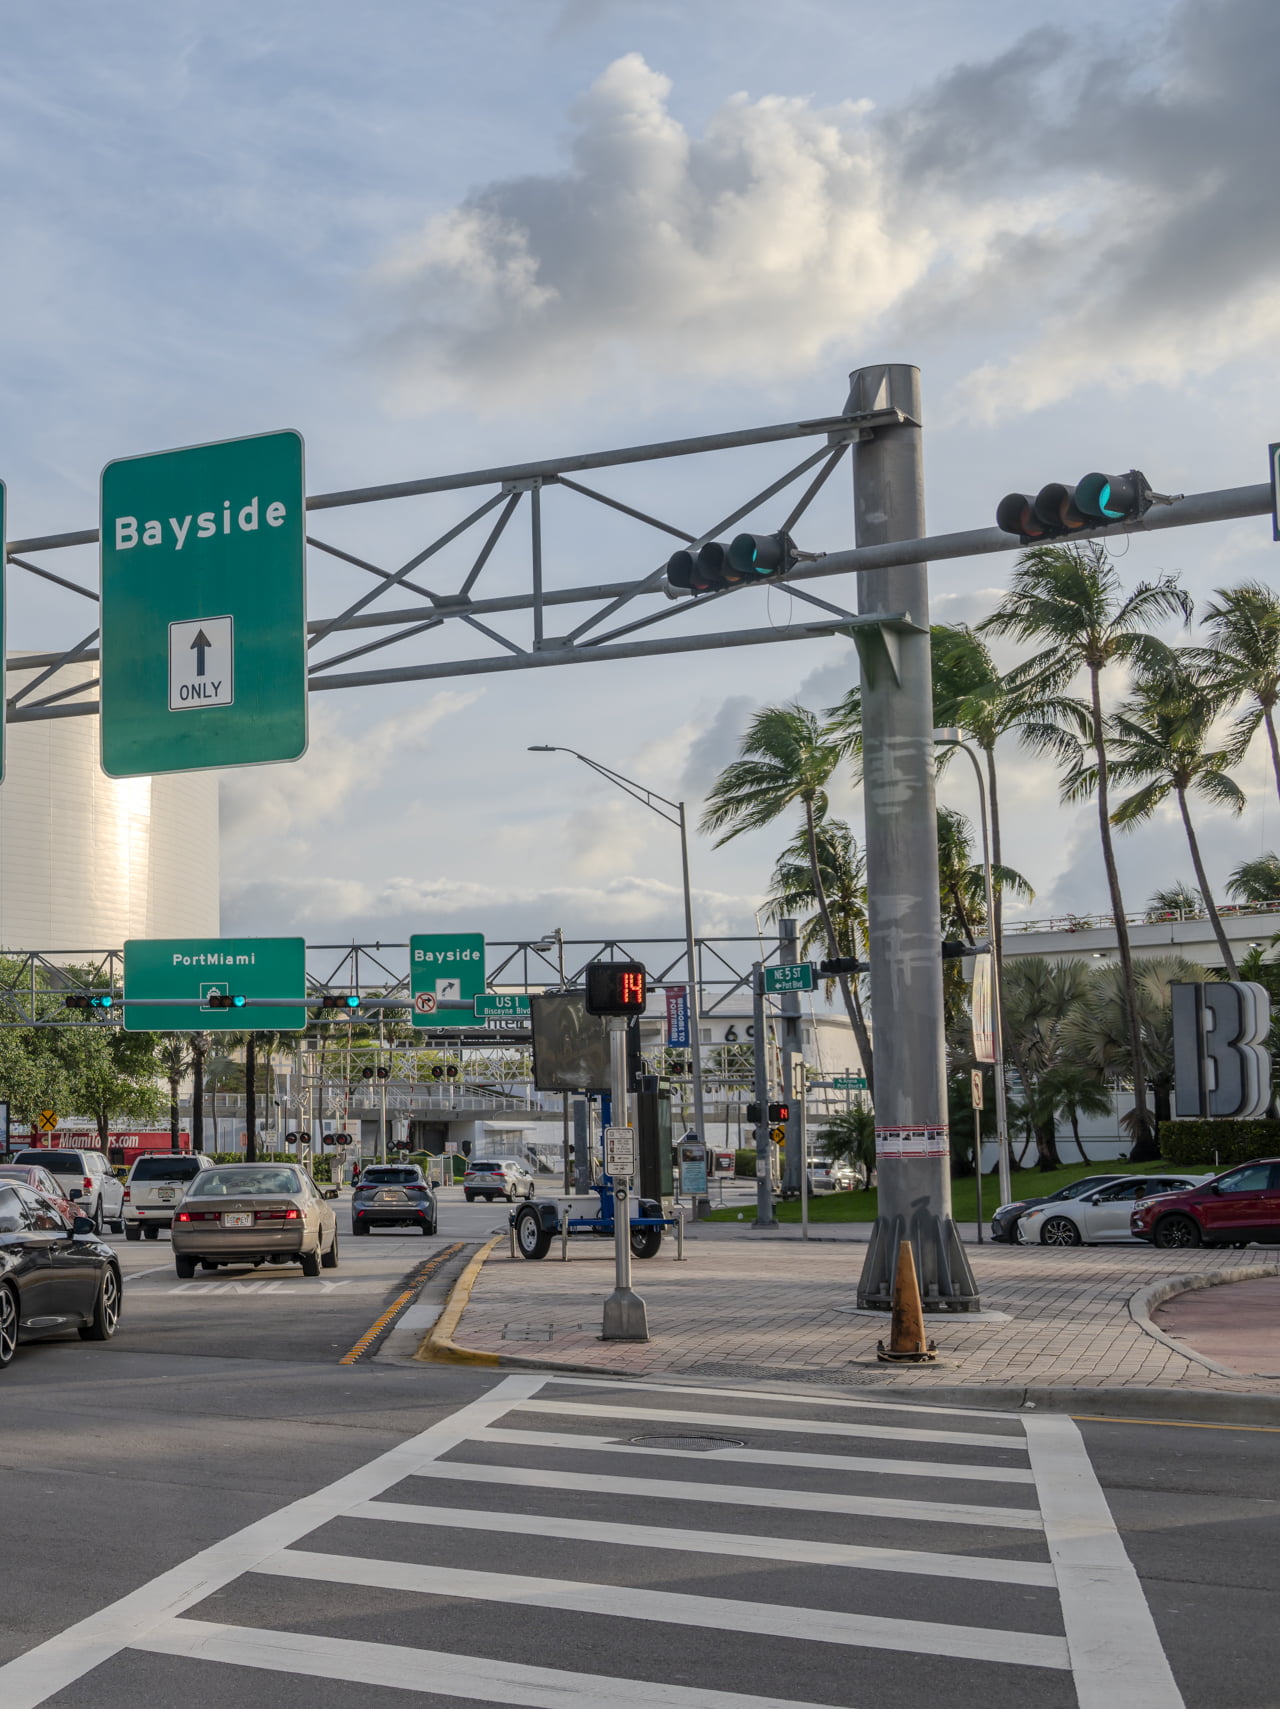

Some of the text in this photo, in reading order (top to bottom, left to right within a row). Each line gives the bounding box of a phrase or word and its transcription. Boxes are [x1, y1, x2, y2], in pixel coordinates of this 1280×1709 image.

[115, 496, 287, 551] Bayside
[179, 681, 222, 701] ONLY
[173, 953, 256, 965] PortMiami
[414, 949, 480, 963] Bayside
[774, 967, 801, 980] NE 5 ST
[622, 972, 643, 1003] 14
[496, 997, 519, 1007] US 1
[59, 1132, 139, 1149] MiamiTors.com
[168, 1281, 352, 1294] ONLY
